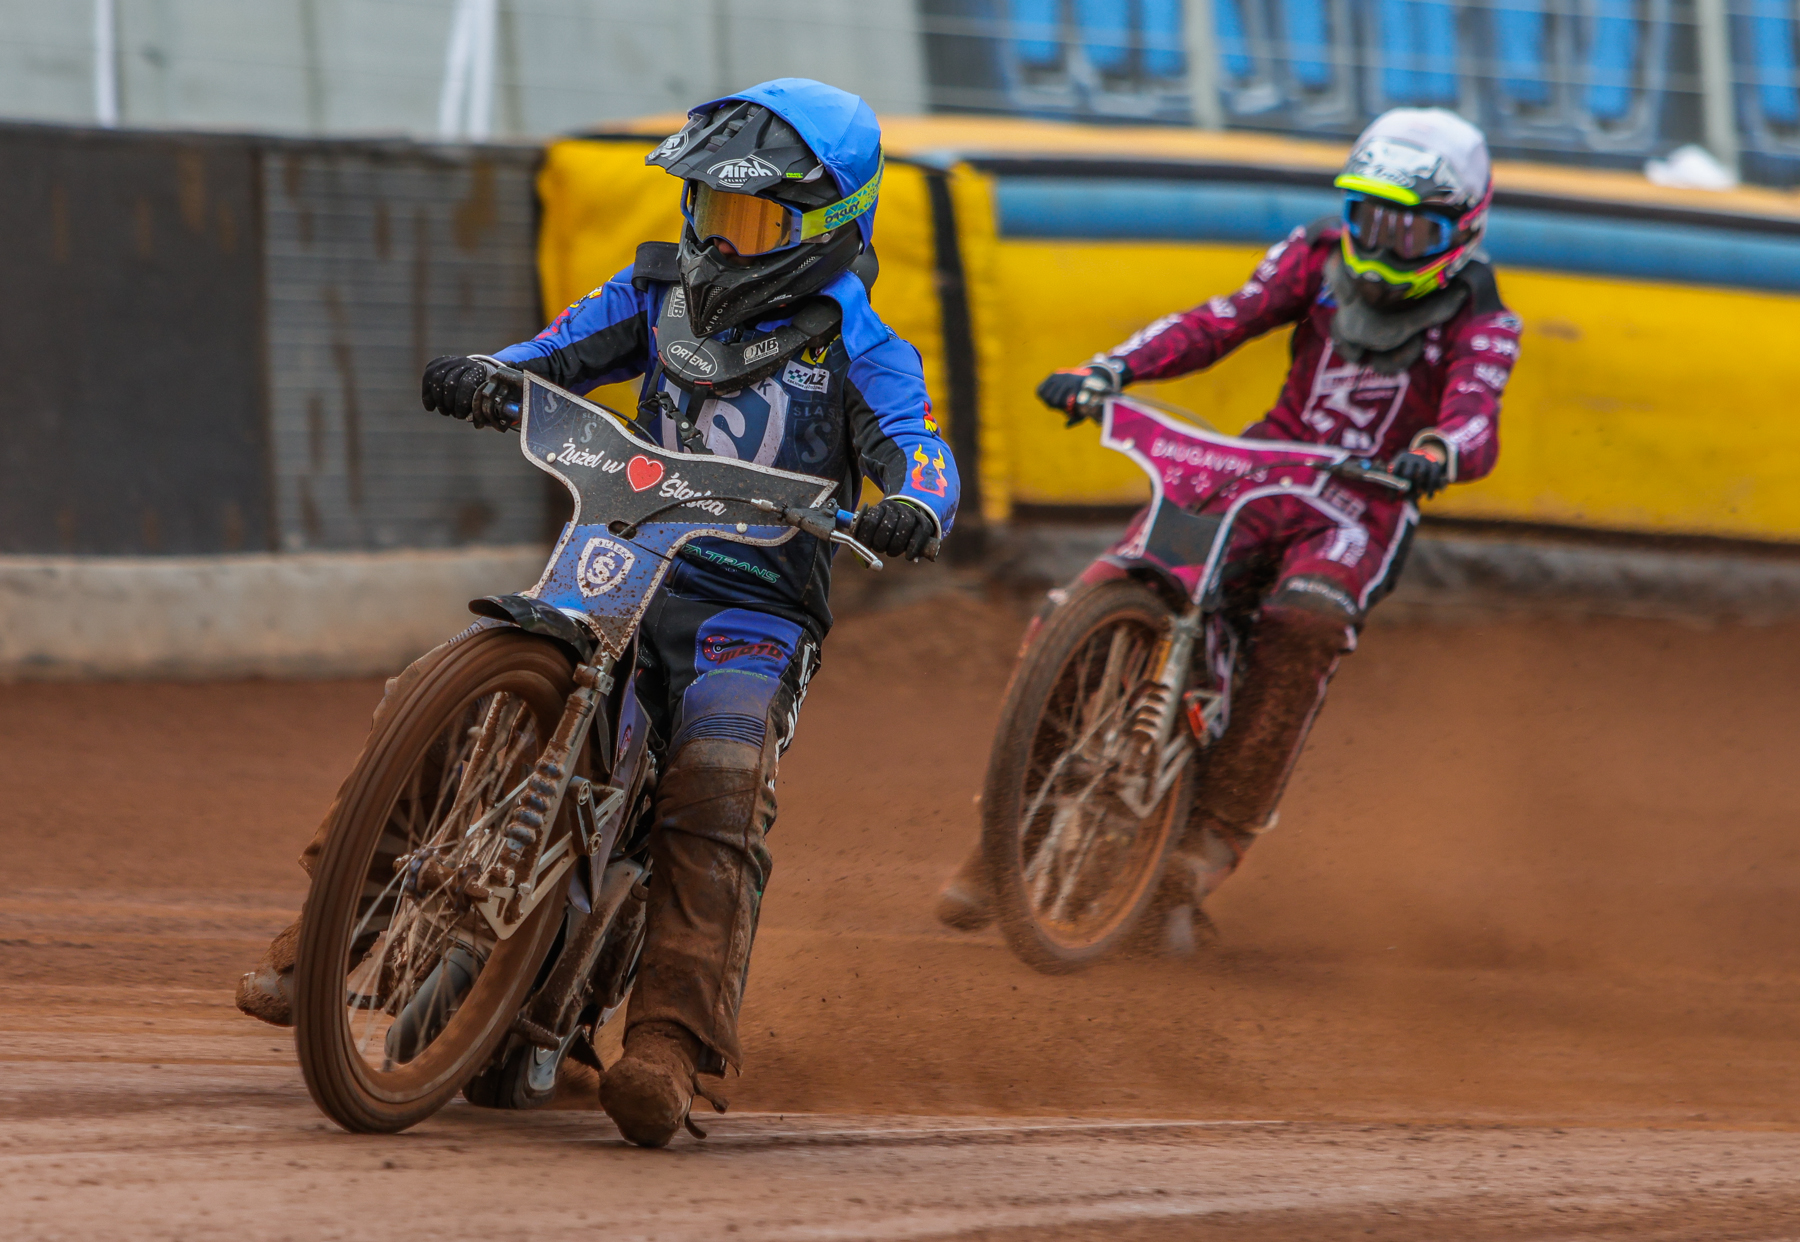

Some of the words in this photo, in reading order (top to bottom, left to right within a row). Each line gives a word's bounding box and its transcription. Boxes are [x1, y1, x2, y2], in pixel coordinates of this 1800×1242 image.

[824, 200, 860, 224] OAKLEY
[705, 300, 729, 332] AIROH
[670, 345, 713, 374] ORTEMA
[556, 437, 605, 468] Żużel
[601, 458, 626, 474] w
[716, 642, 784, 665] MOTO
